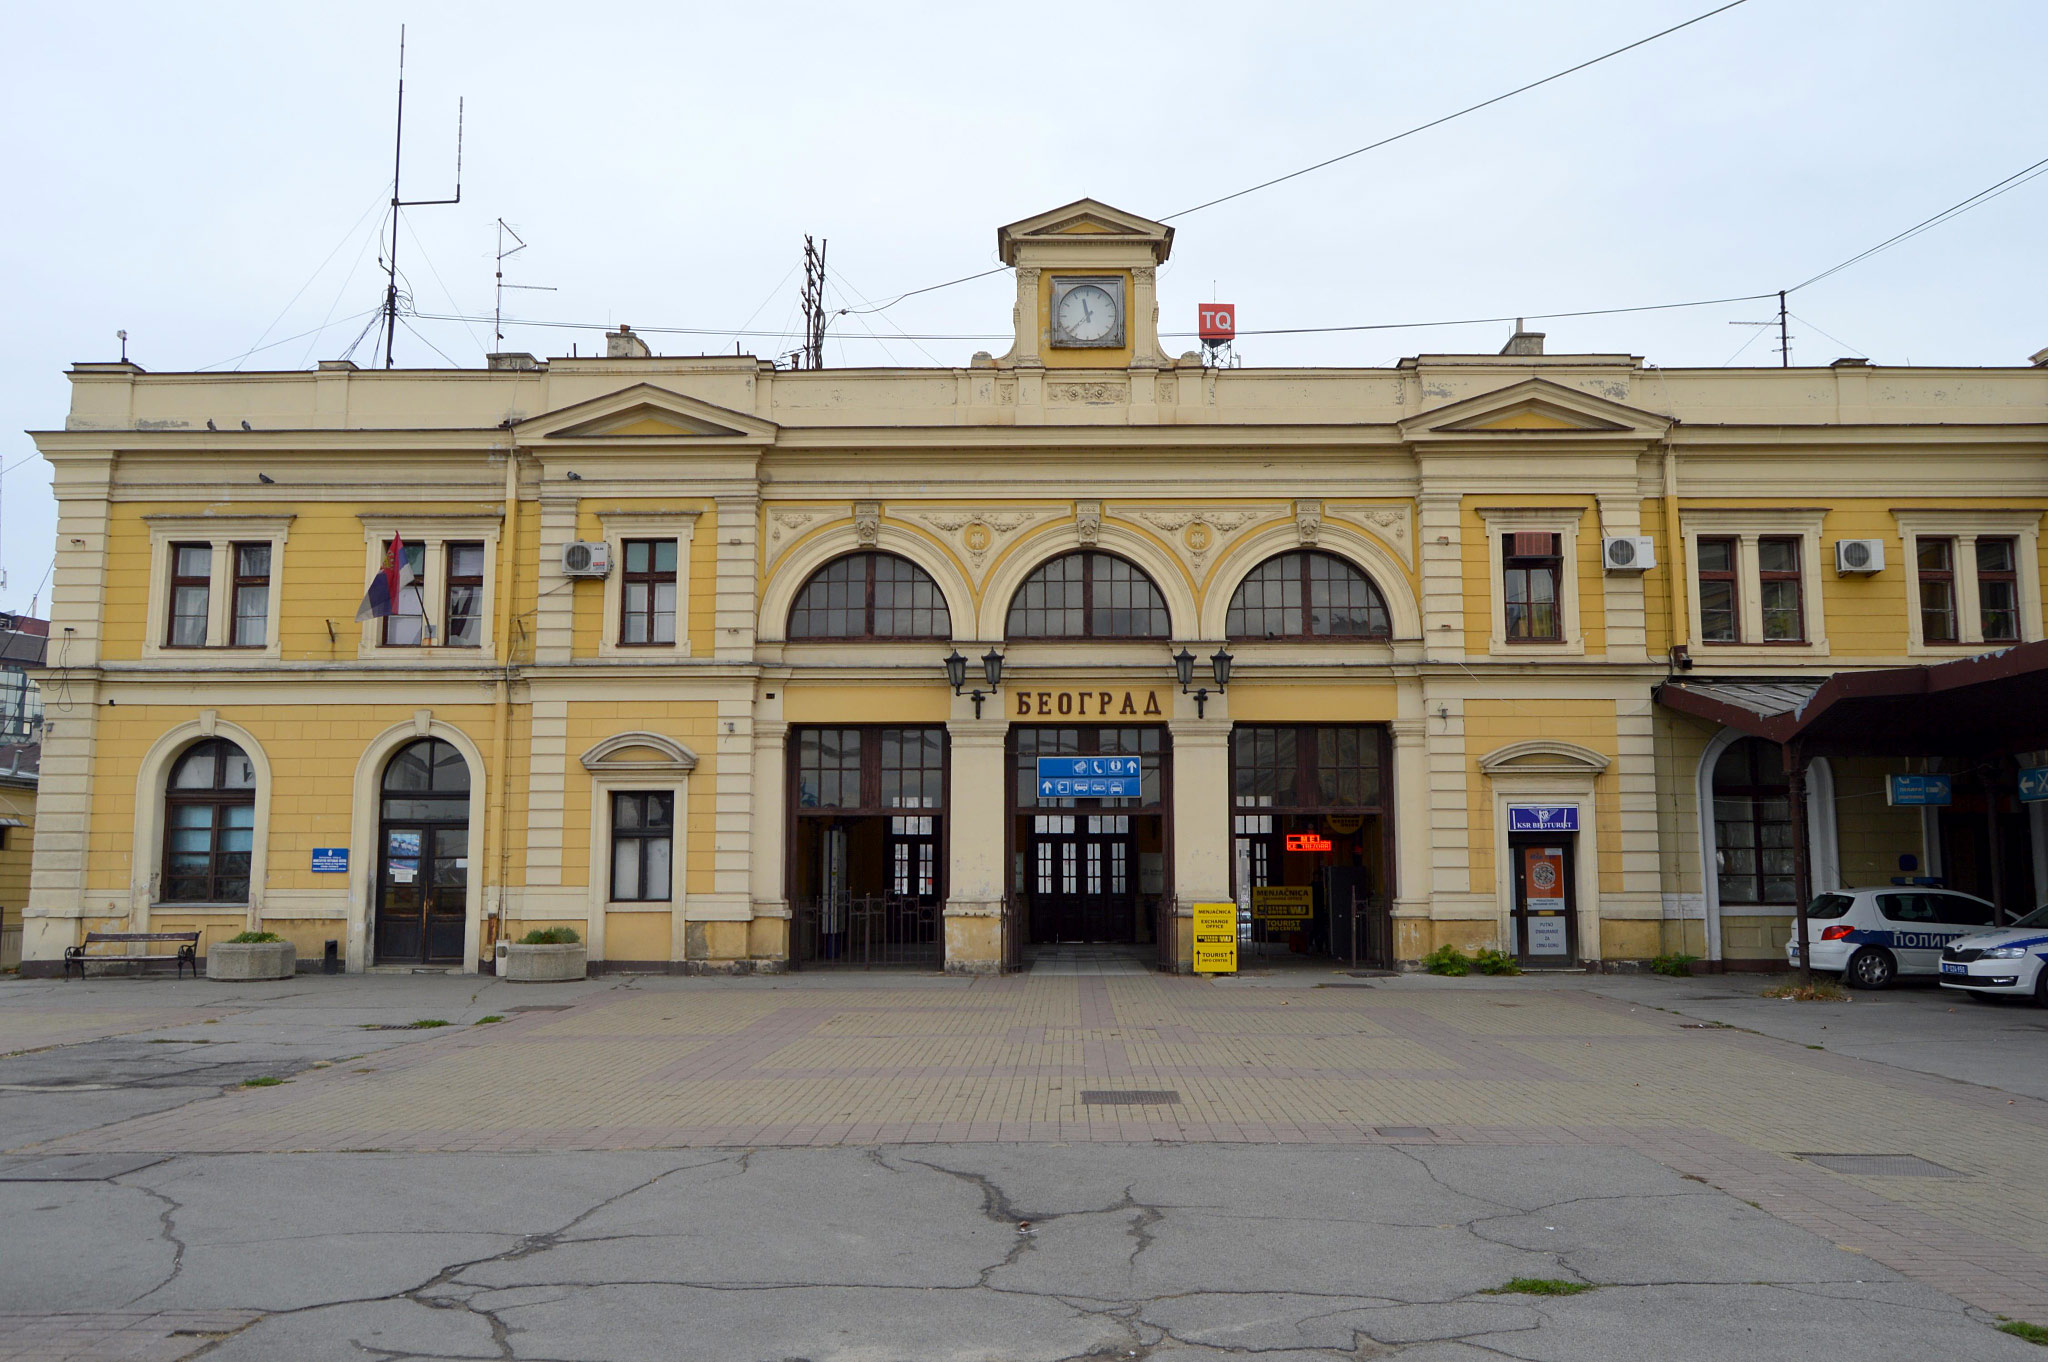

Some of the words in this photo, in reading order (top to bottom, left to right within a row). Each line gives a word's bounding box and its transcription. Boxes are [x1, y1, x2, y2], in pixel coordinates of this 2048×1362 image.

[1202, 311, 1231, 330] TQ
[1016, 690, 1161, 715] БЕОГРАД
[1256, 888, 1309, 897] MENJAČNICA
